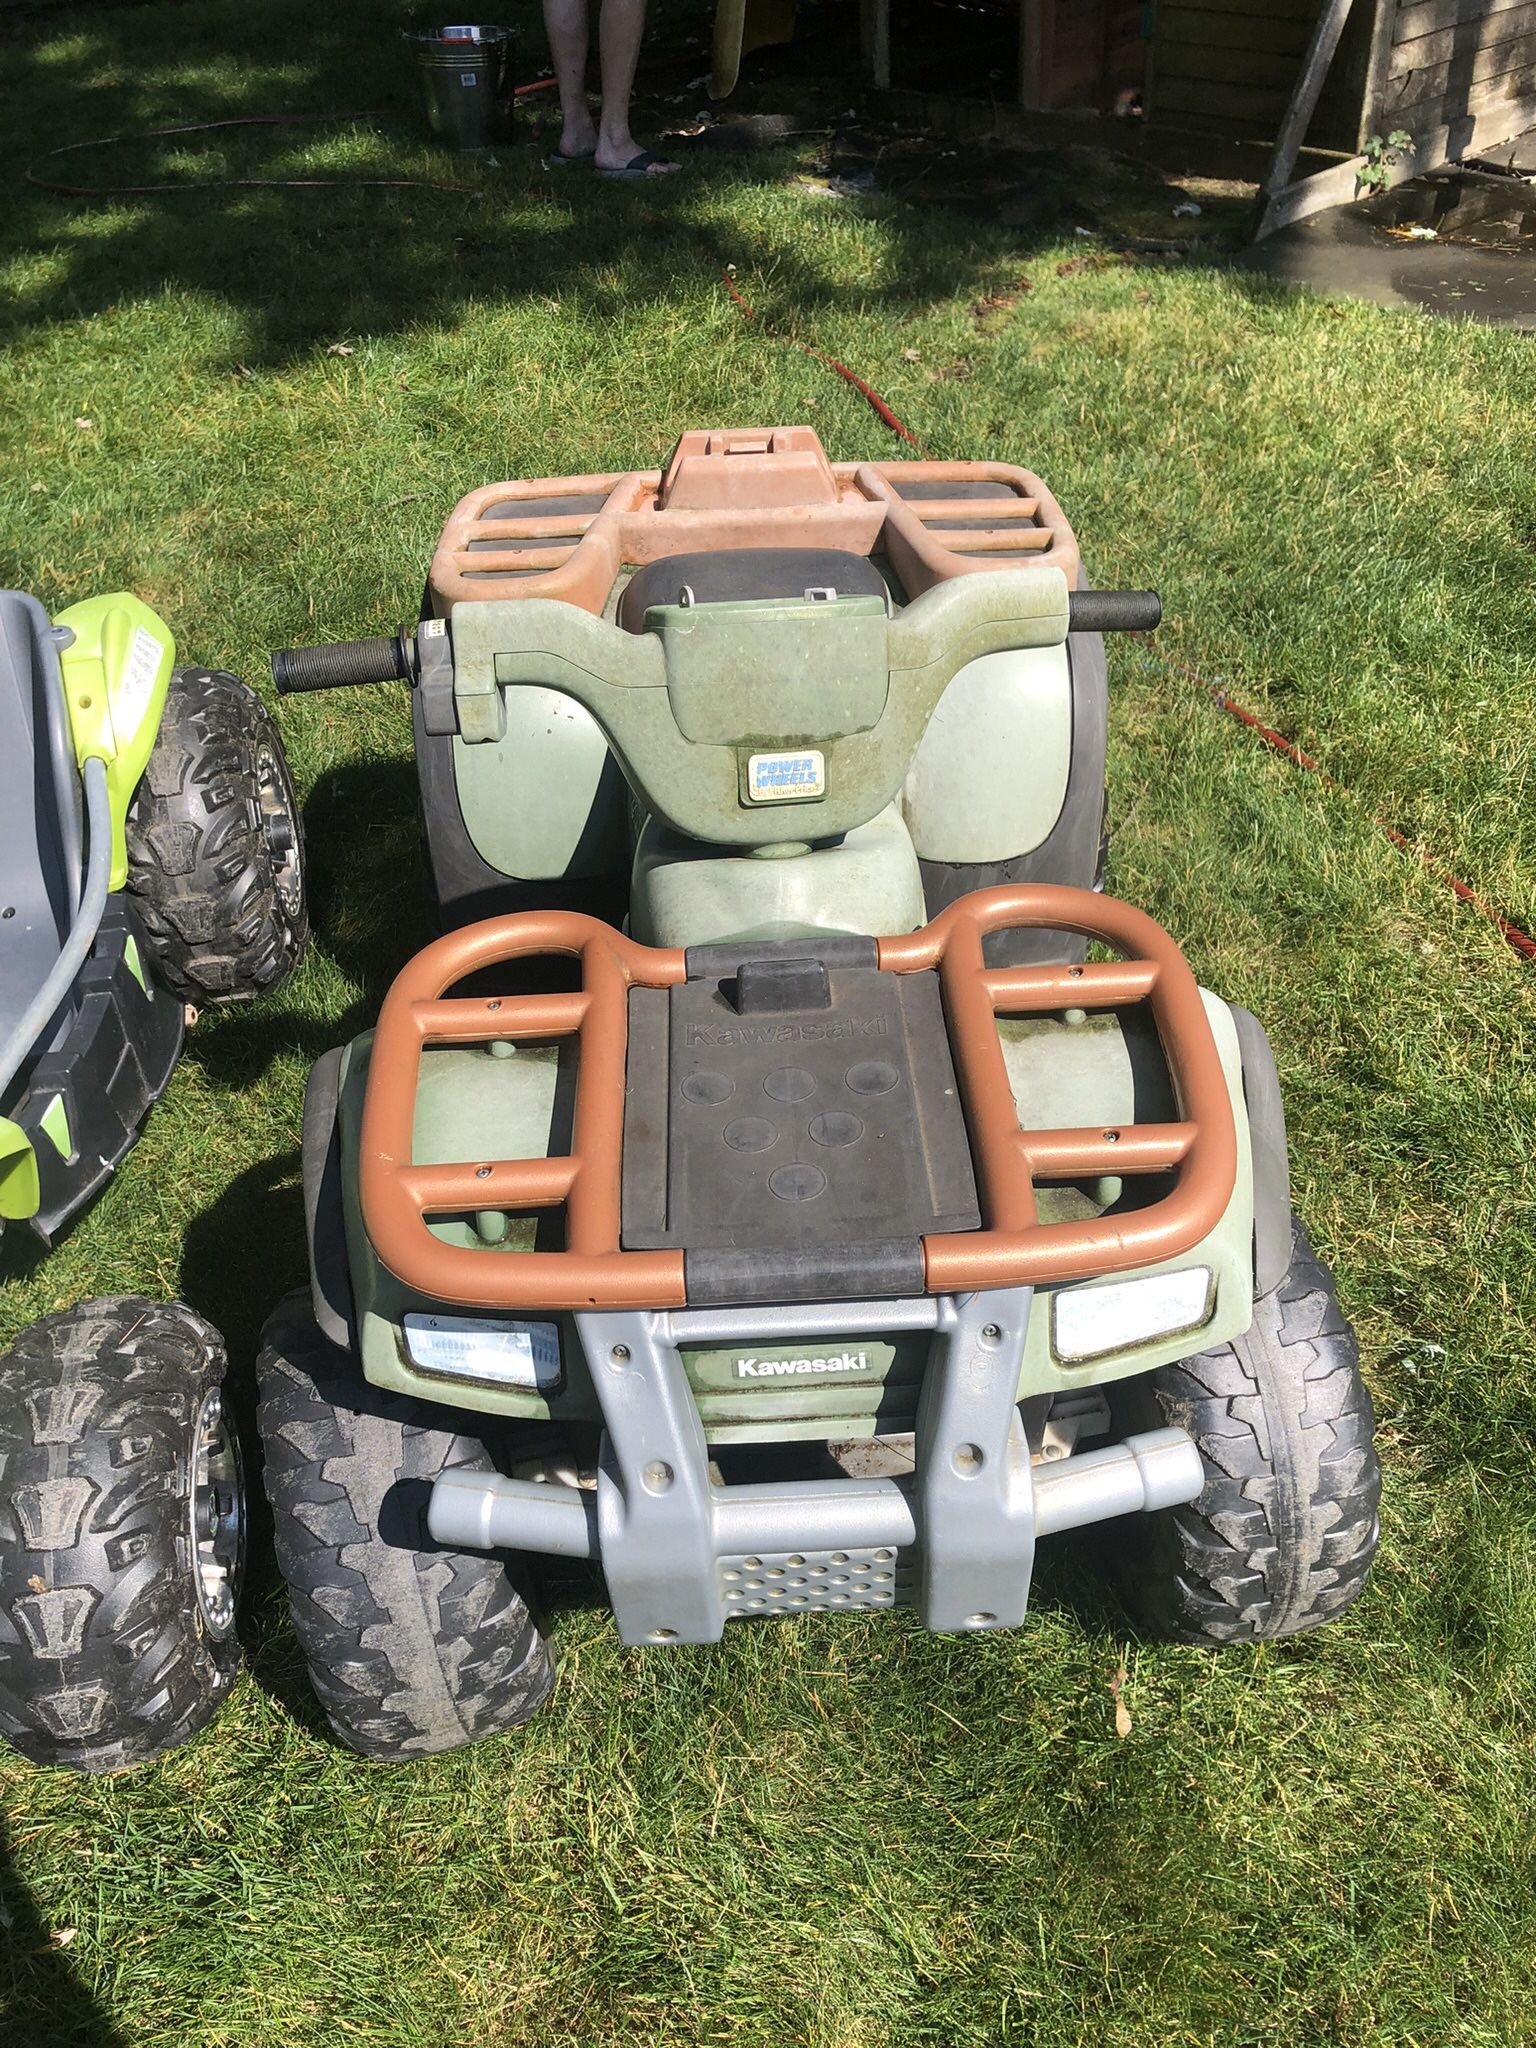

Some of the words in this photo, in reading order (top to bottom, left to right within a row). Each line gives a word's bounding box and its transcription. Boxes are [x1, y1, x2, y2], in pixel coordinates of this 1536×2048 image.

[756, 759, 813, 774] POWER
[756, 772, 817, 787] WHEELS
[685, 1015, 887, 1047] Kawasaki
[738, 1352, 866, 1377] Kawasaki
